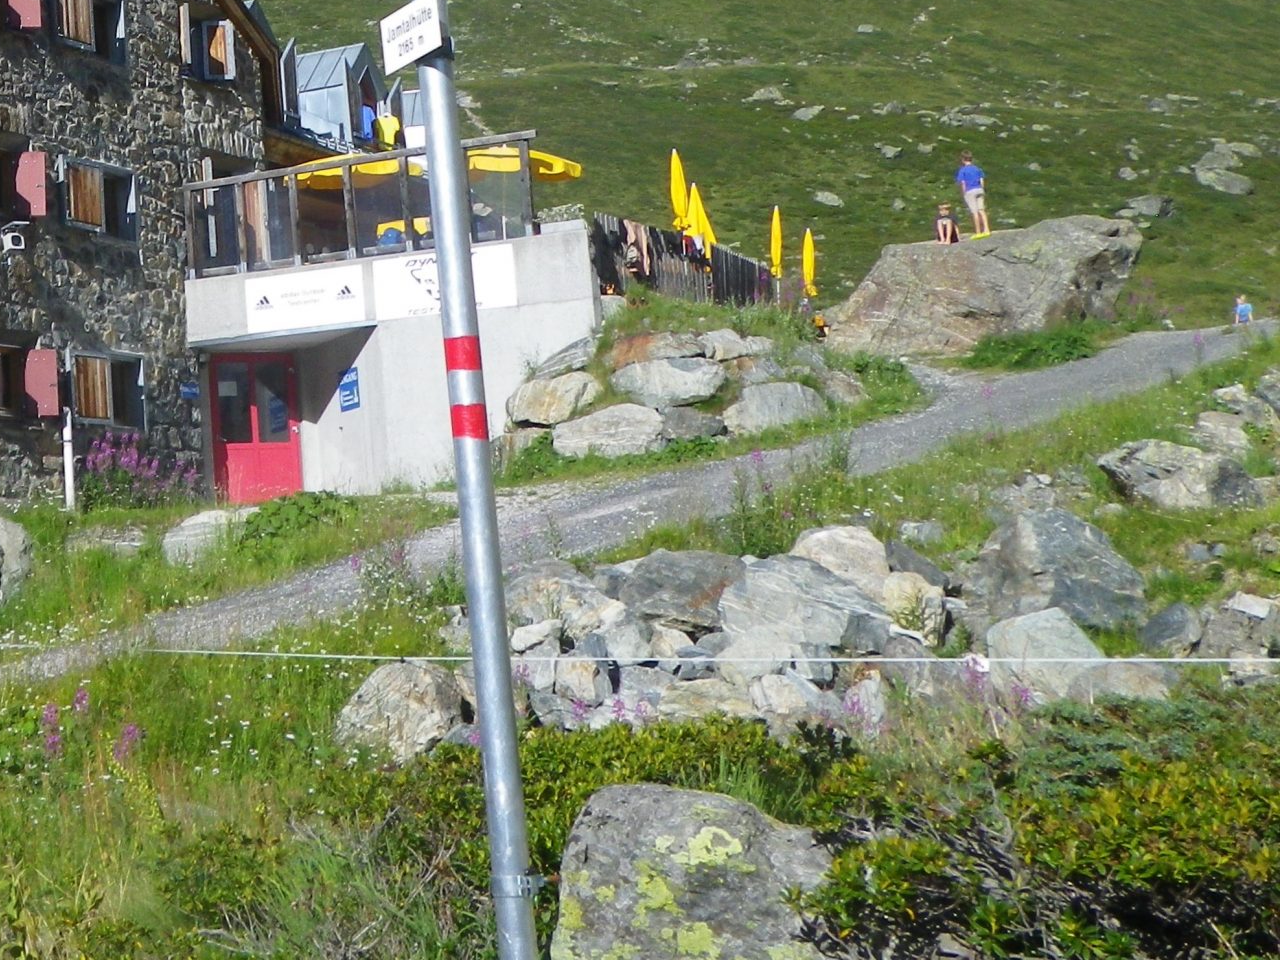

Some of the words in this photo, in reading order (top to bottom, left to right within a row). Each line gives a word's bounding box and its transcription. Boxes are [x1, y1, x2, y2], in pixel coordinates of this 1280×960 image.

[386, 6, 433, 44] Jamtalhütte
[397, 37, 415, 58] 2165
[417, 34, 425, 46] m
